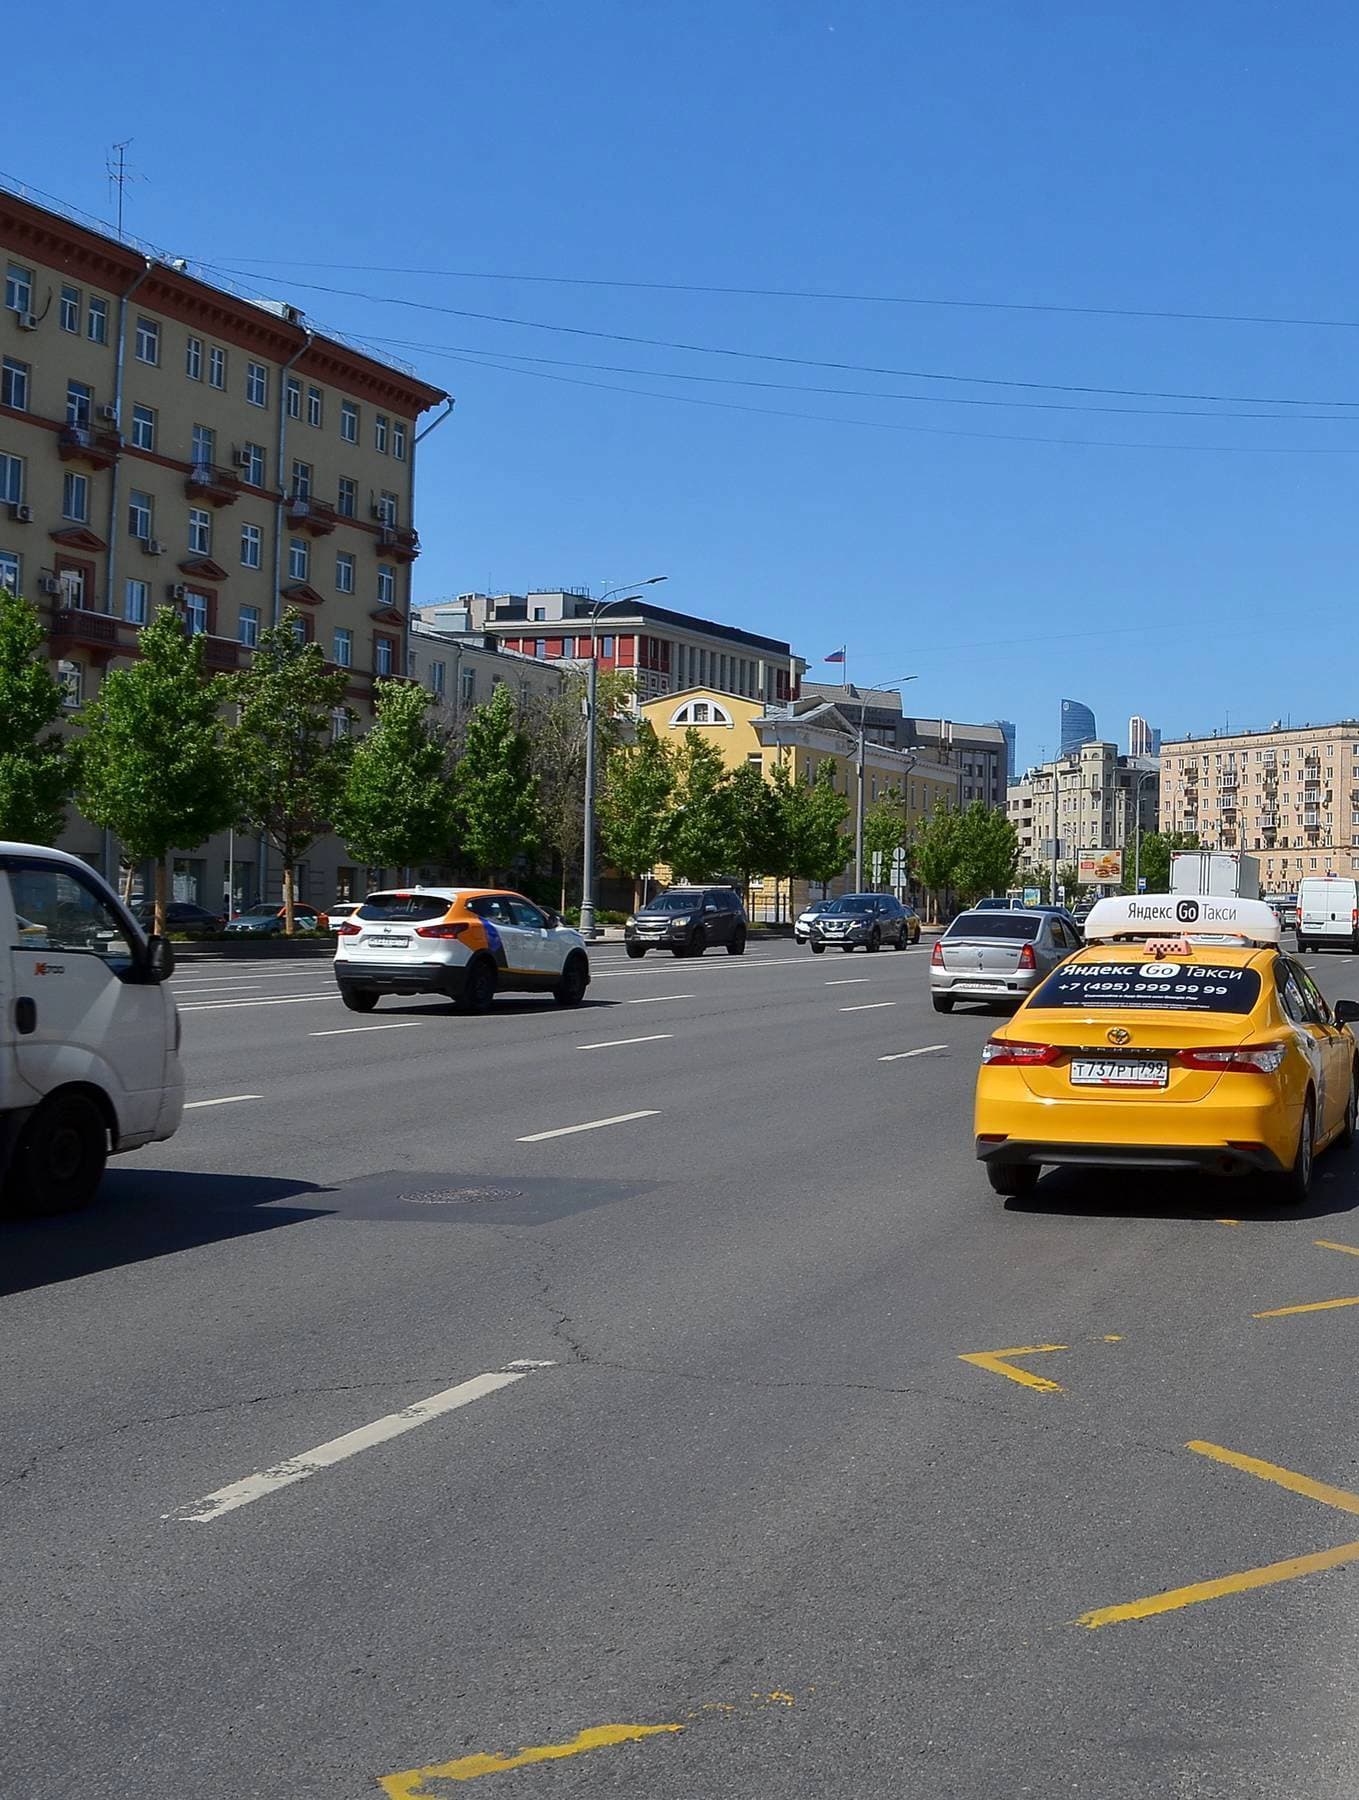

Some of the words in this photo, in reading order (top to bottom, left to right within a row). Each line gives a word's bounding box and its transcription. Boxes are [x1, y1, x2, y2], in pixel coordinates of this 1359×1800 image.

[1128, 902, 1172, 919] Яндекс
[1178, 901, 1198, 921] Go
[1202, 904, 1237, 920] Такси
[1060, 964, 1135, 976] Яндекс
[1143, 964, 1177, 976] Go
[1186, 965, 1243, 980] Такси
[1058, 982, 1080, 991] +7
[1083, 982, 1130, 992] (495)
[1134, 983, 1171, 992] 999
[1175, 984, 1199, 993] 99
[1203, 985, 1228, 995] 99
